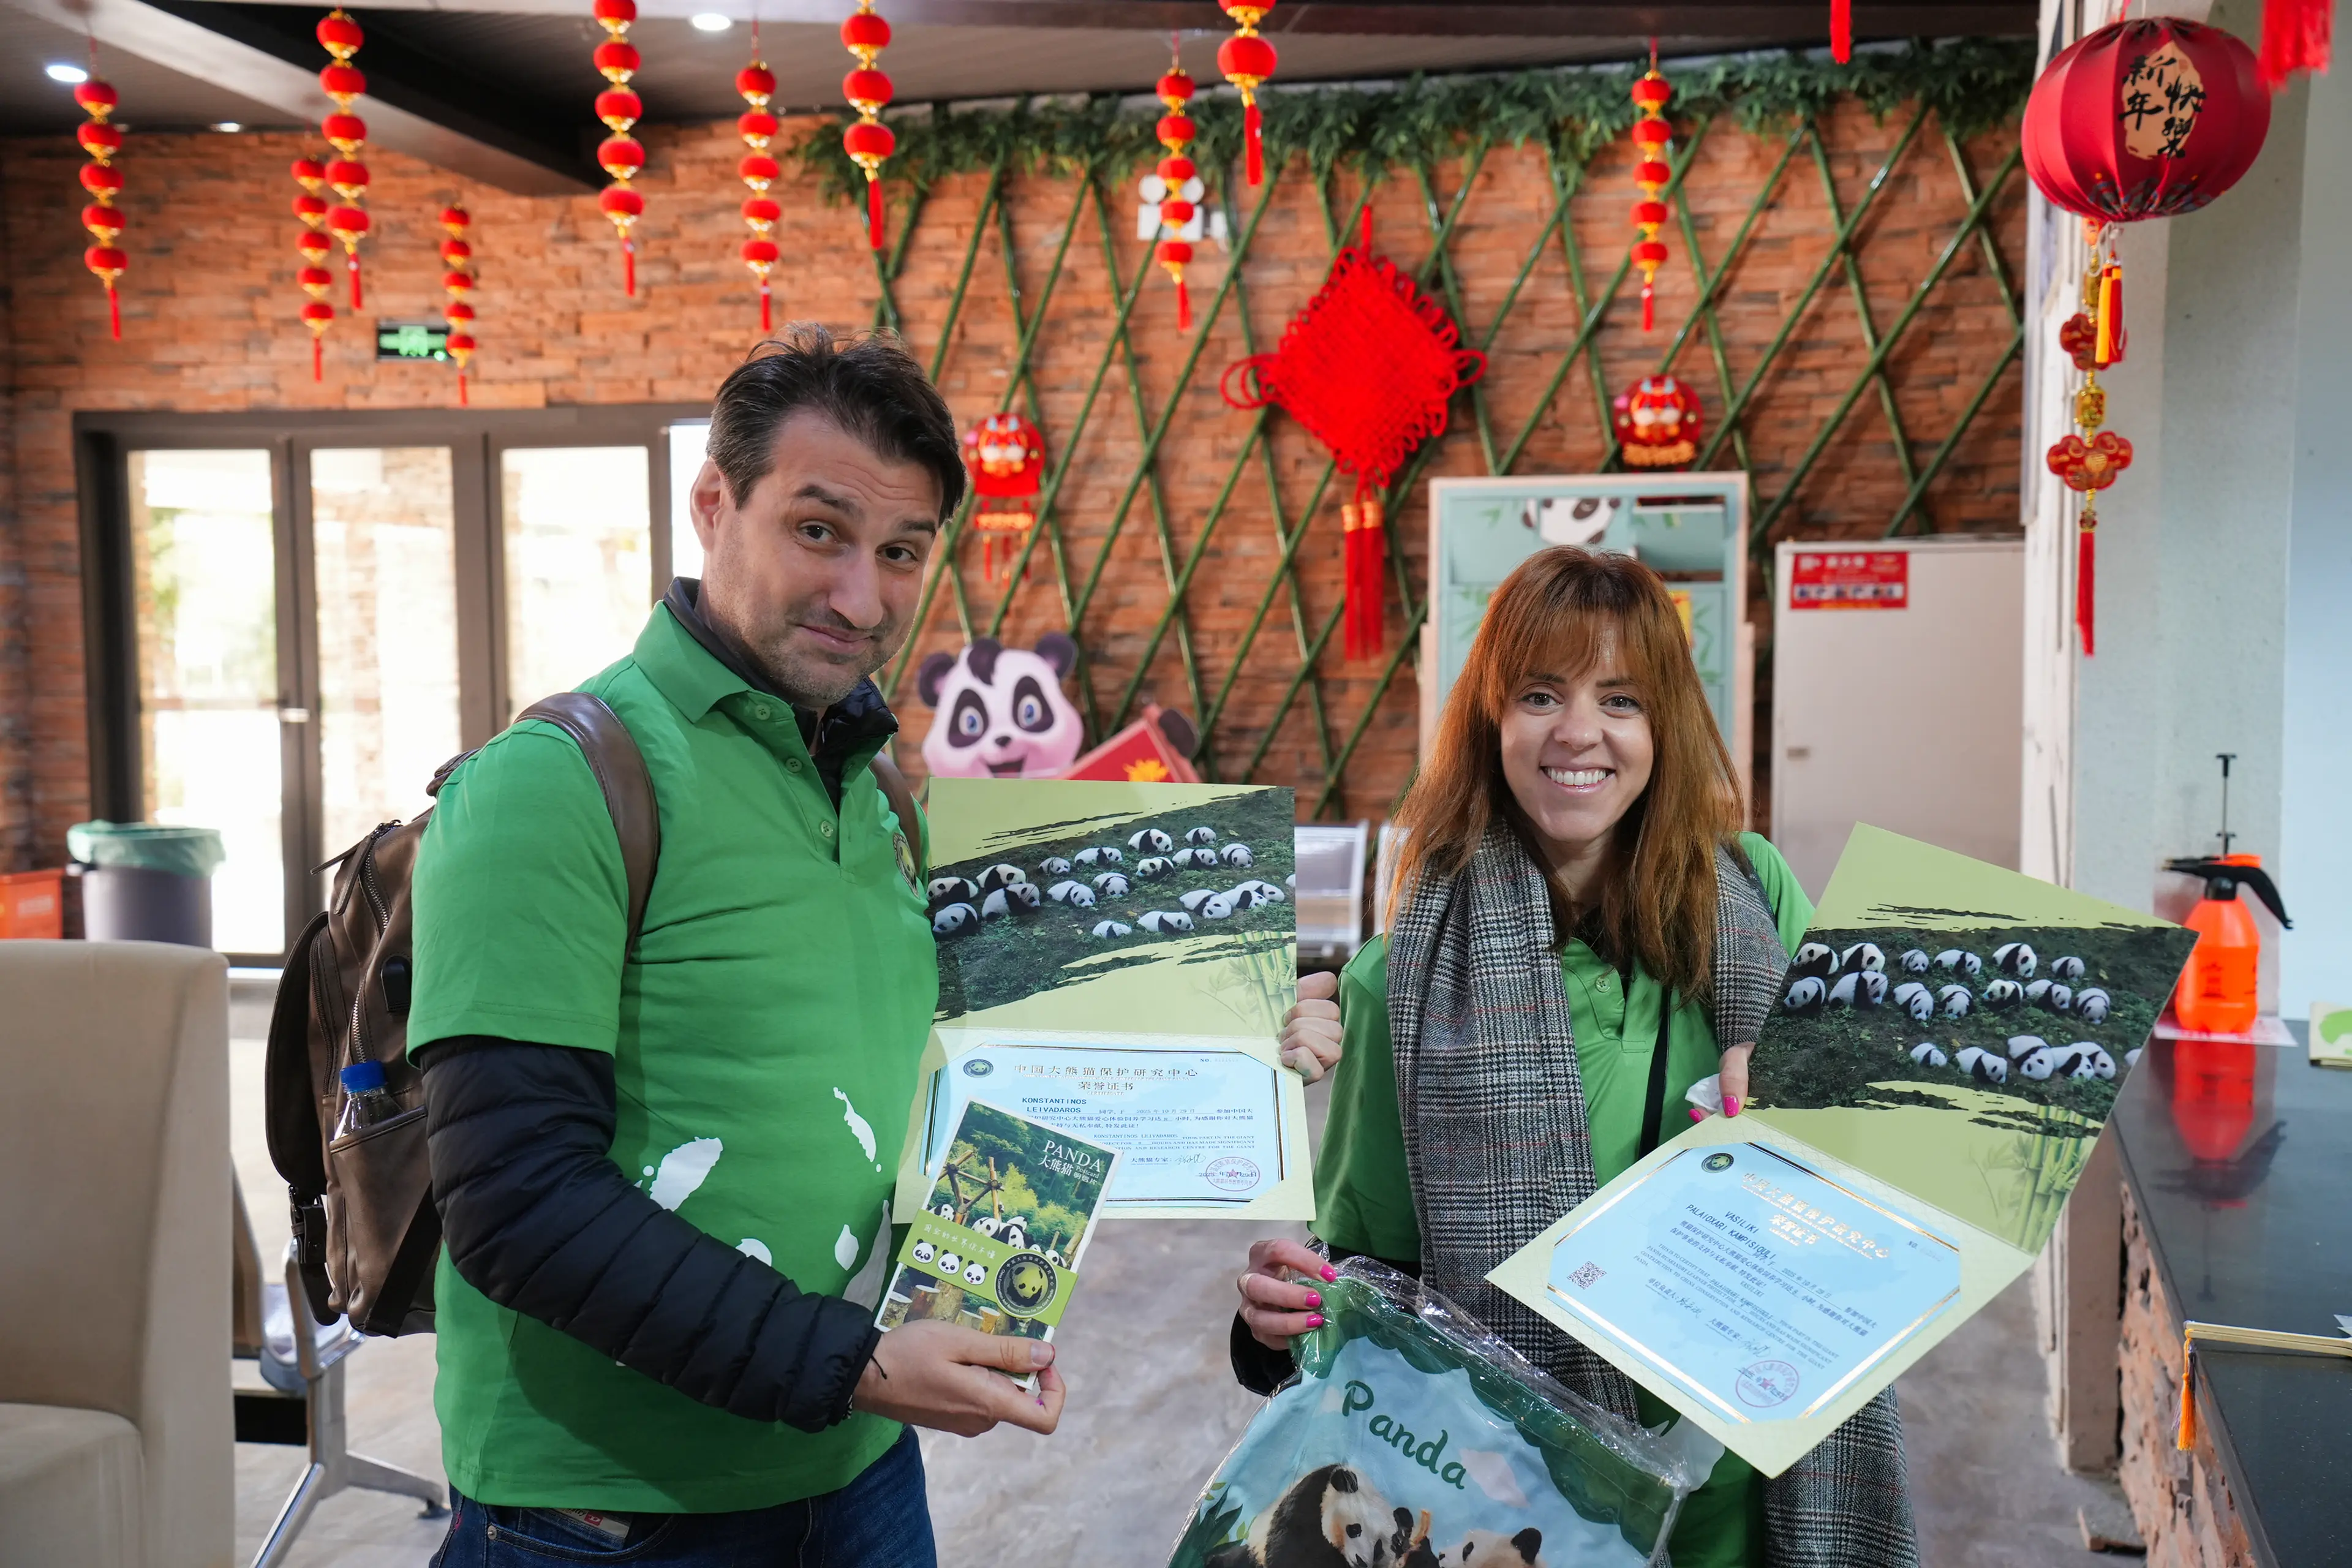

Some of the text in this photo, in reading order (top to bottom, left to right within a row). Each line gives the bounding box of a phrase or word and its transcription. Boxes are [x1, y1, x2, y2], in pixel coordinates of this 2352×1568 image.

[1014, 1064, 1198, 1077] 中国大熊猫保护研究中心
[1078, 1081, 1134, 1091] 荣誉证书
[1038, 1155, 1074, 1176] 大熊猫
[1042, 1139, 1101, 1173] PANDA
[1073, 1172, 1097, 1185] 明信片
[1076, 1166, 1100, 1178] Postcard
[1686, 1204, 1727, 1231] PALAIOXARI
[1728, 1229, 1776, 1259] KAMPISIOULI
[1724, 1211, 1758, 1234] VASILIKI
[1341, 1380, 1467, 1490] Panda
